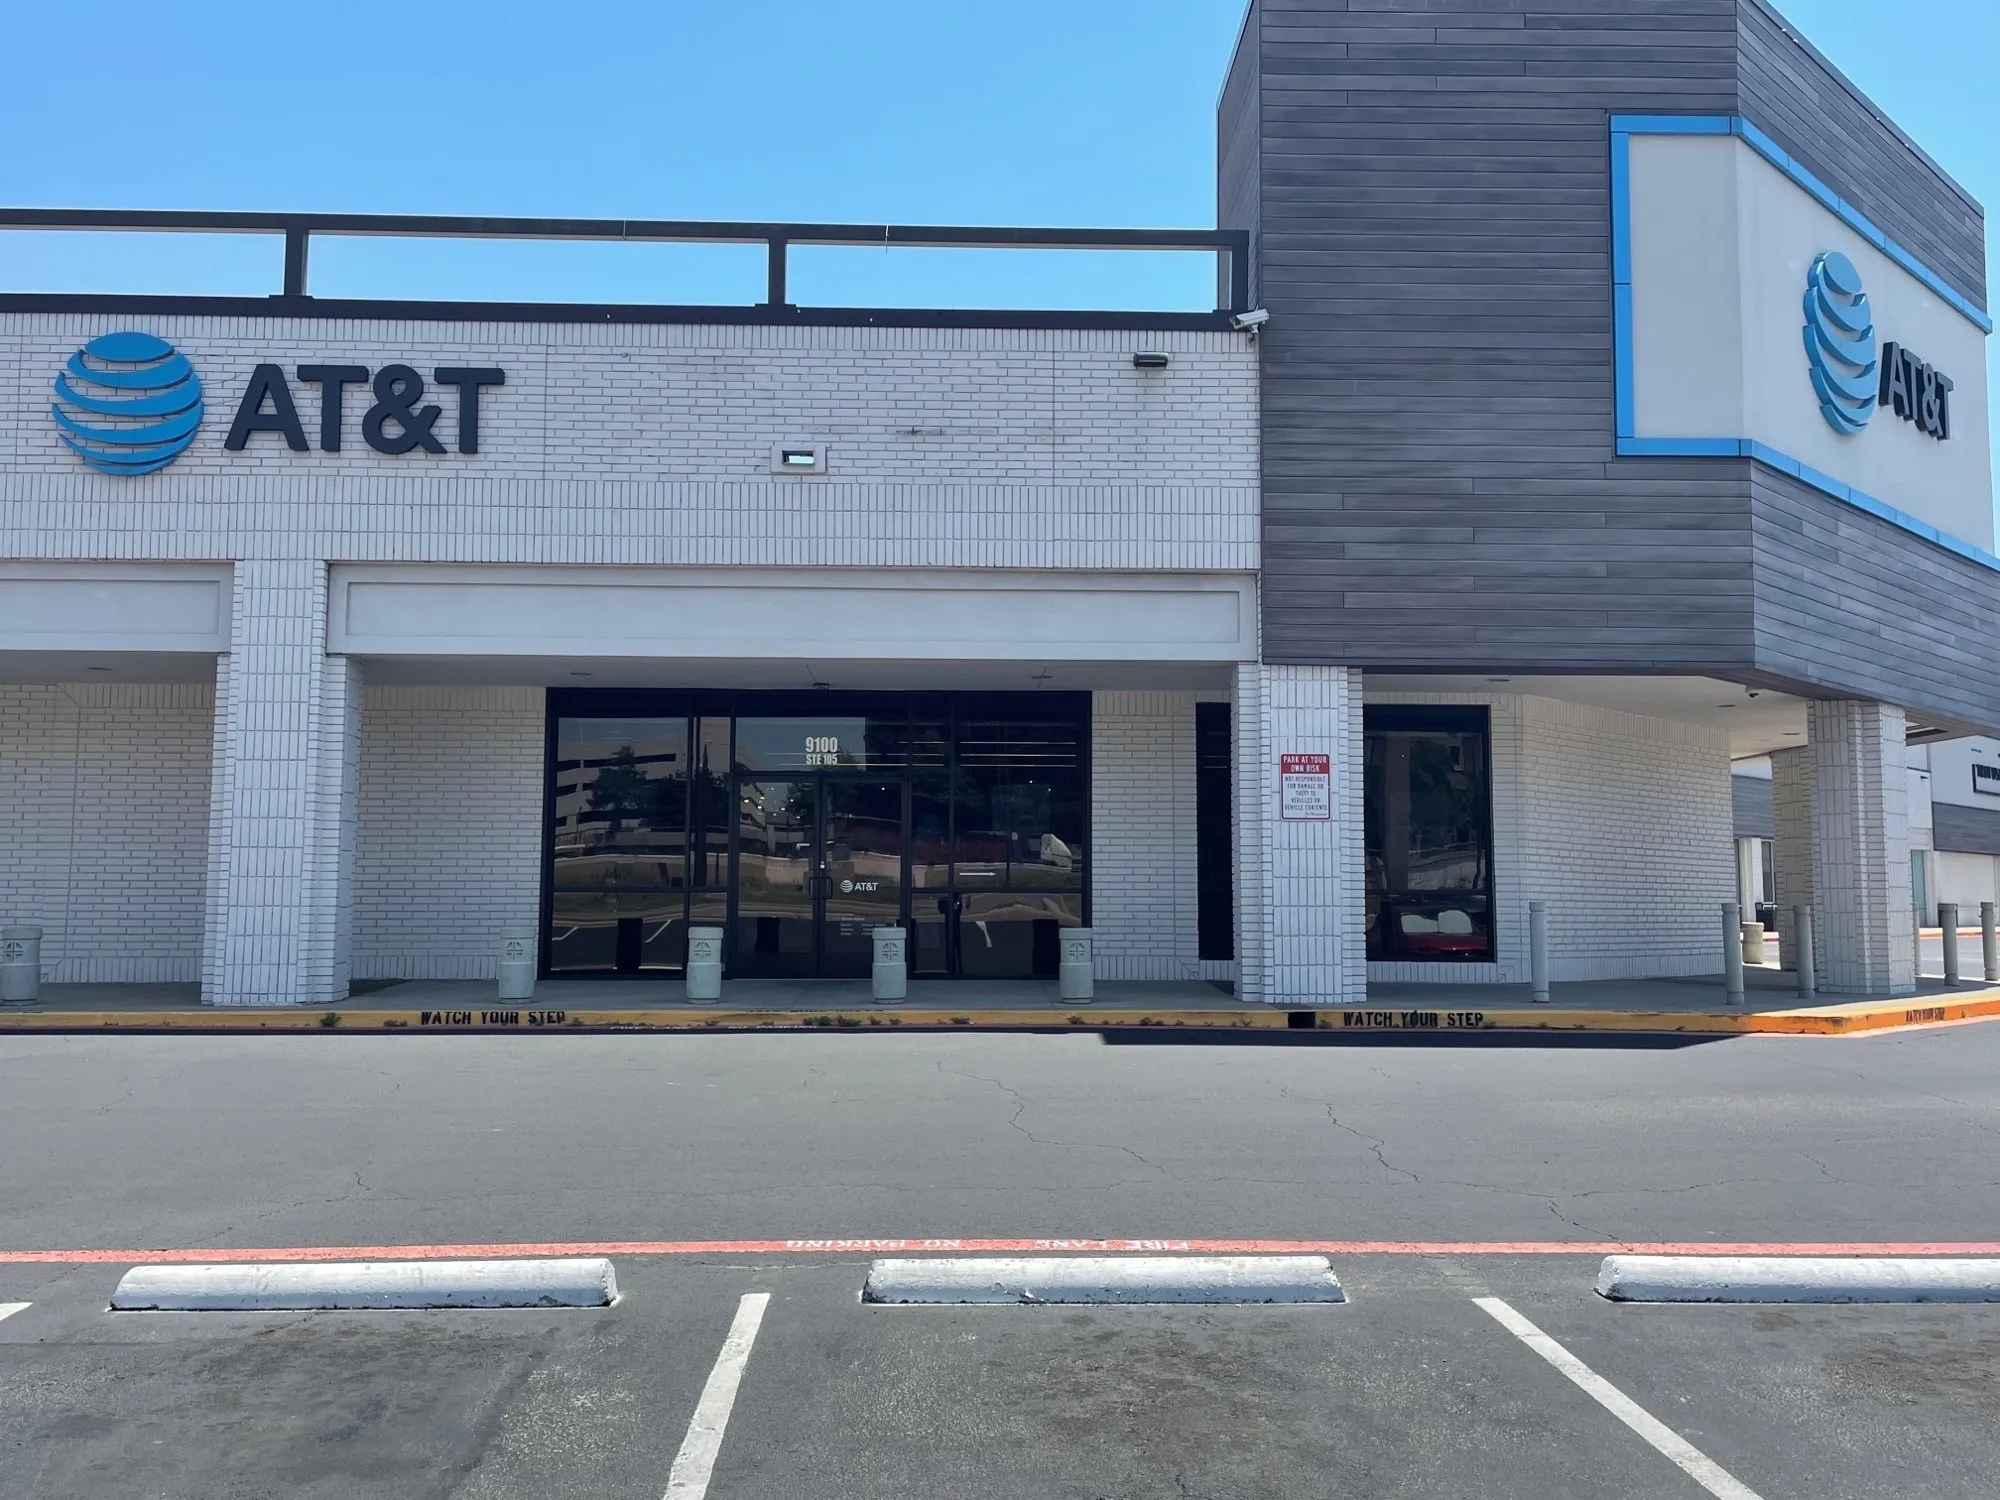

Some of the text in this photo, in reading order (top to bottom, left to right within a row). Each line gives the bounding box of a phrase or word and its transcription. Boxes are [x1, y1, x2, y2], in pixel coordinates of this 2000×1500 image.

[1878, 341, 1954, 440] AT&T
[223, 363, 505, 455] AT&T
[805, 736, 838, 753] 9100
[805, 754, 838, 765] STE 105
[1283, 755, 1327, 764] PARK AT YOUR
[1290, 764, 1320, 772] OWN RISK
[854, 882, 878, 891] AT&T
[420, 1011, 566, 1025] WATCH YOUR STEP
[1343, 1011, 1484, 1027] WATCH YOUR STEP
[924, 1239, 961, 1248] NO
[1125, 1239, 1189, 1250] FIRE
